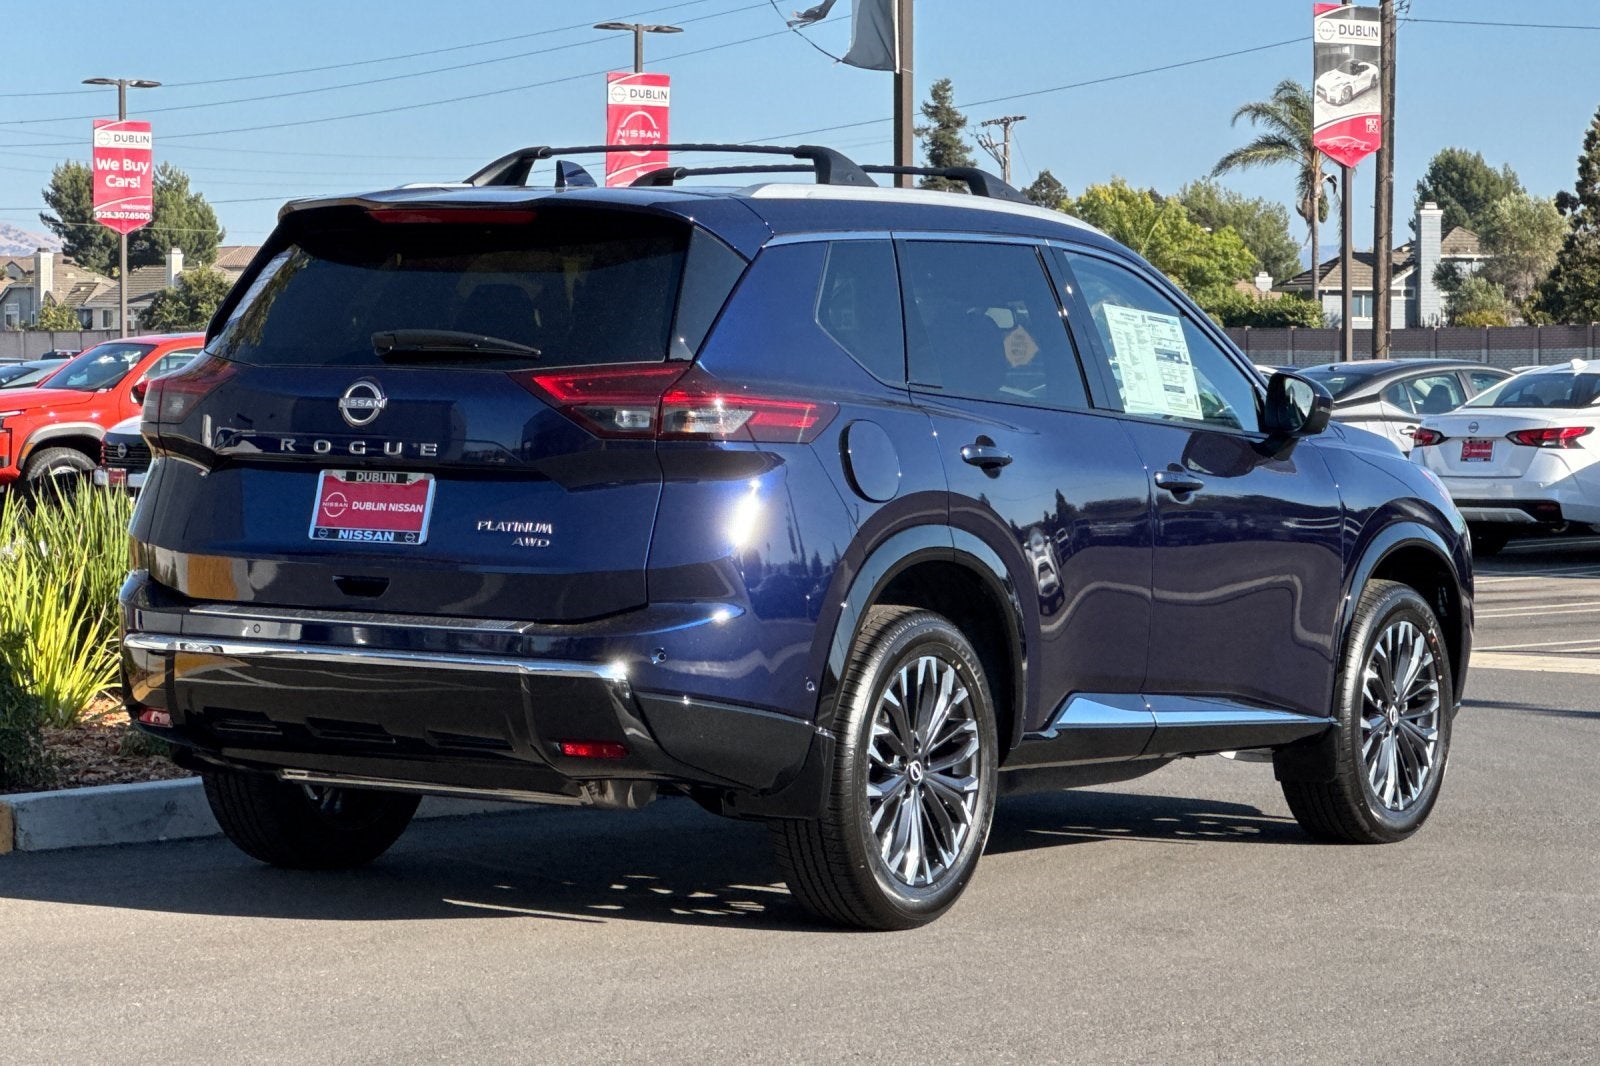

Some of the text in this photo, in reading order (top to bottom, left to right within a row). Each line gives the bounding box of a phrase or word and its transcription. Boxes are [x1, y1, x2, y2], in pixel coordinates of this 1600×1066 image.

[1338, 24, 1379, 38] DUBLIN
[630, 88, 668, 100] DUBLIN
[113, 134, 150, 144] DUBLIN
[617, 129, 661, 139] NISSAN
[96, 158, 150, 175] We Buy
[105, 175, 141, 188] Cars!
[340, 399, 384, 408] NISSAN
[280, 438, 438, 457] ROGUE
[356, 472, 397, 482] DUBLIN
[351, 501, 424, 512] DUBLIN NISSAN
[477, 520, 553, 534] PLATINUM
[337, 529, 395, 541] NISSAN
[511, 537, 550, 547] AWD
